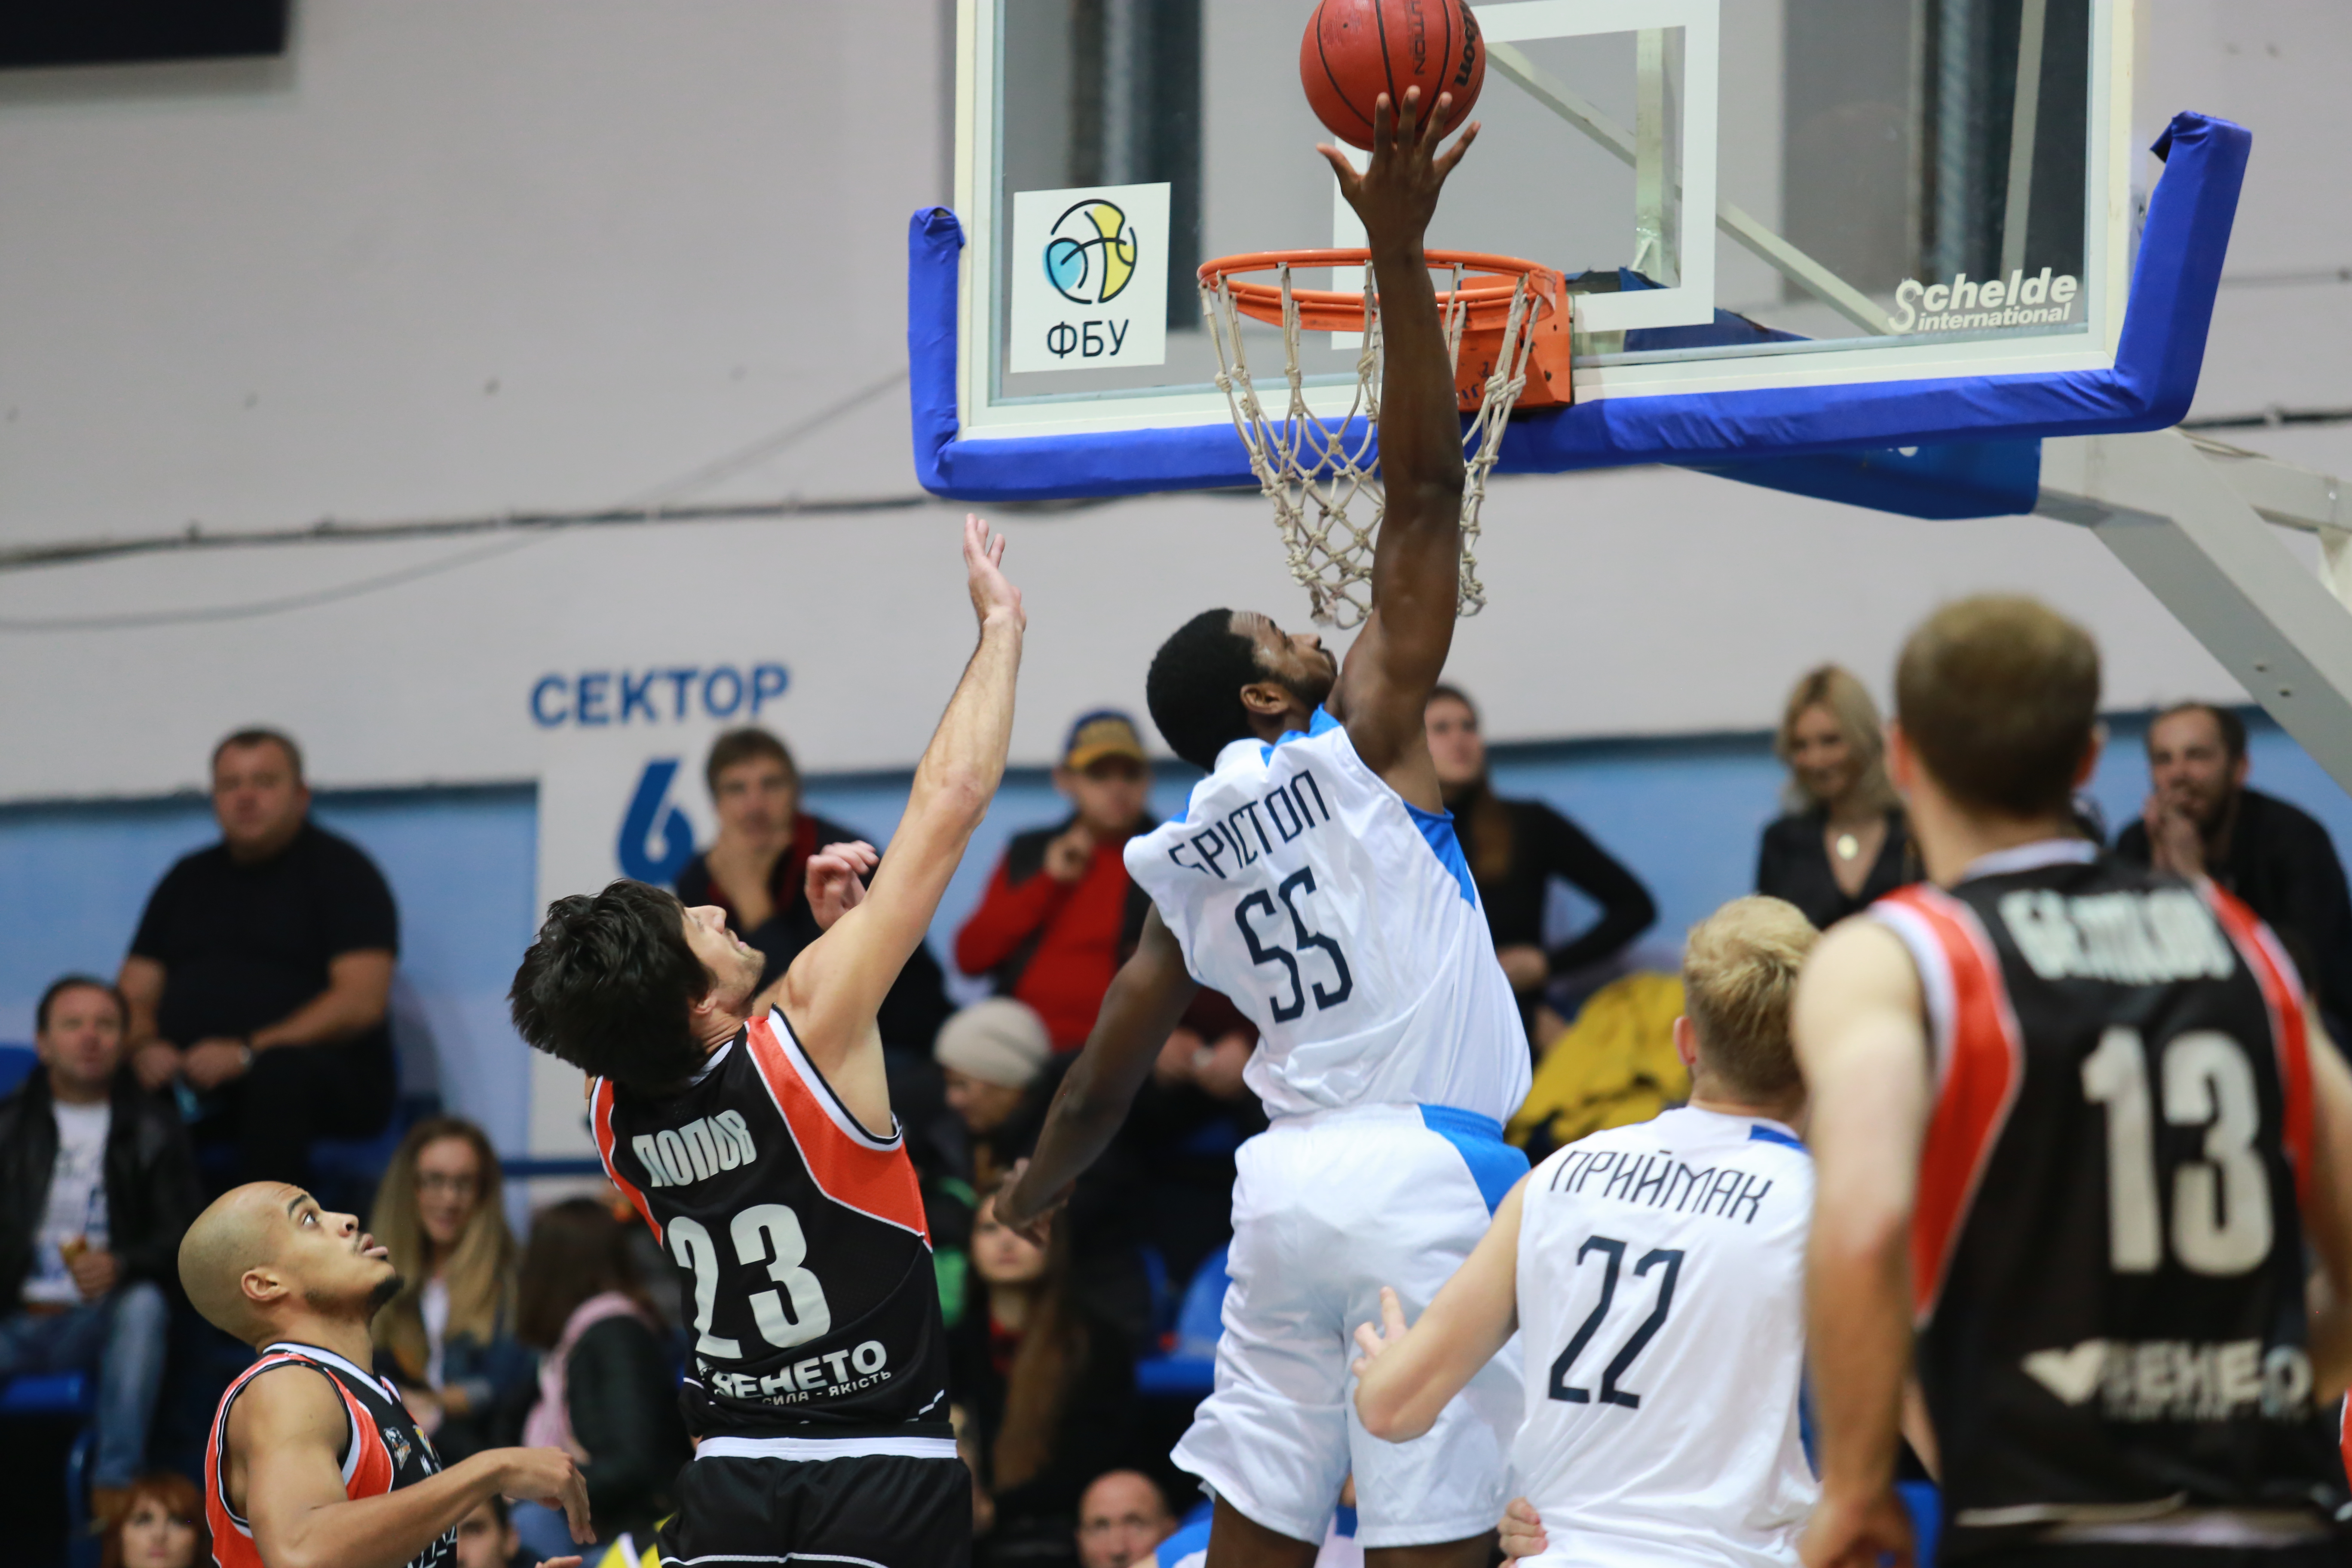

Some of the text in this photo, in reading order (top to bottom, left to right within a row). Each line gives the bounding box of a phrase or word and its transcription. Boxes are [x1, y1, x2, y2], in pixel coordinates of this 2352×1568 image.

[1888, 267, 2077, 332] Schelde
[1917, 302, 2071, 331] international
[1047, 319, 1129, 358] ФБУ
[530, 665, 790, 726] СЕКТОР
[617, 759, 695, 893] 6
[1234, 865, 1353, 1024] 55
[632, 1109, 757, 1188] ПОПОВ
[1549, 1149, 1774, 1225] ПРИЙМАК
[2081, 1026, 2274, 1277] 13
[667, 1204, 831, 1359] 23
[1548, 1235, 1686, 1410] 22
[829, 1370, 892, 1397] ЯКІСТЬ
